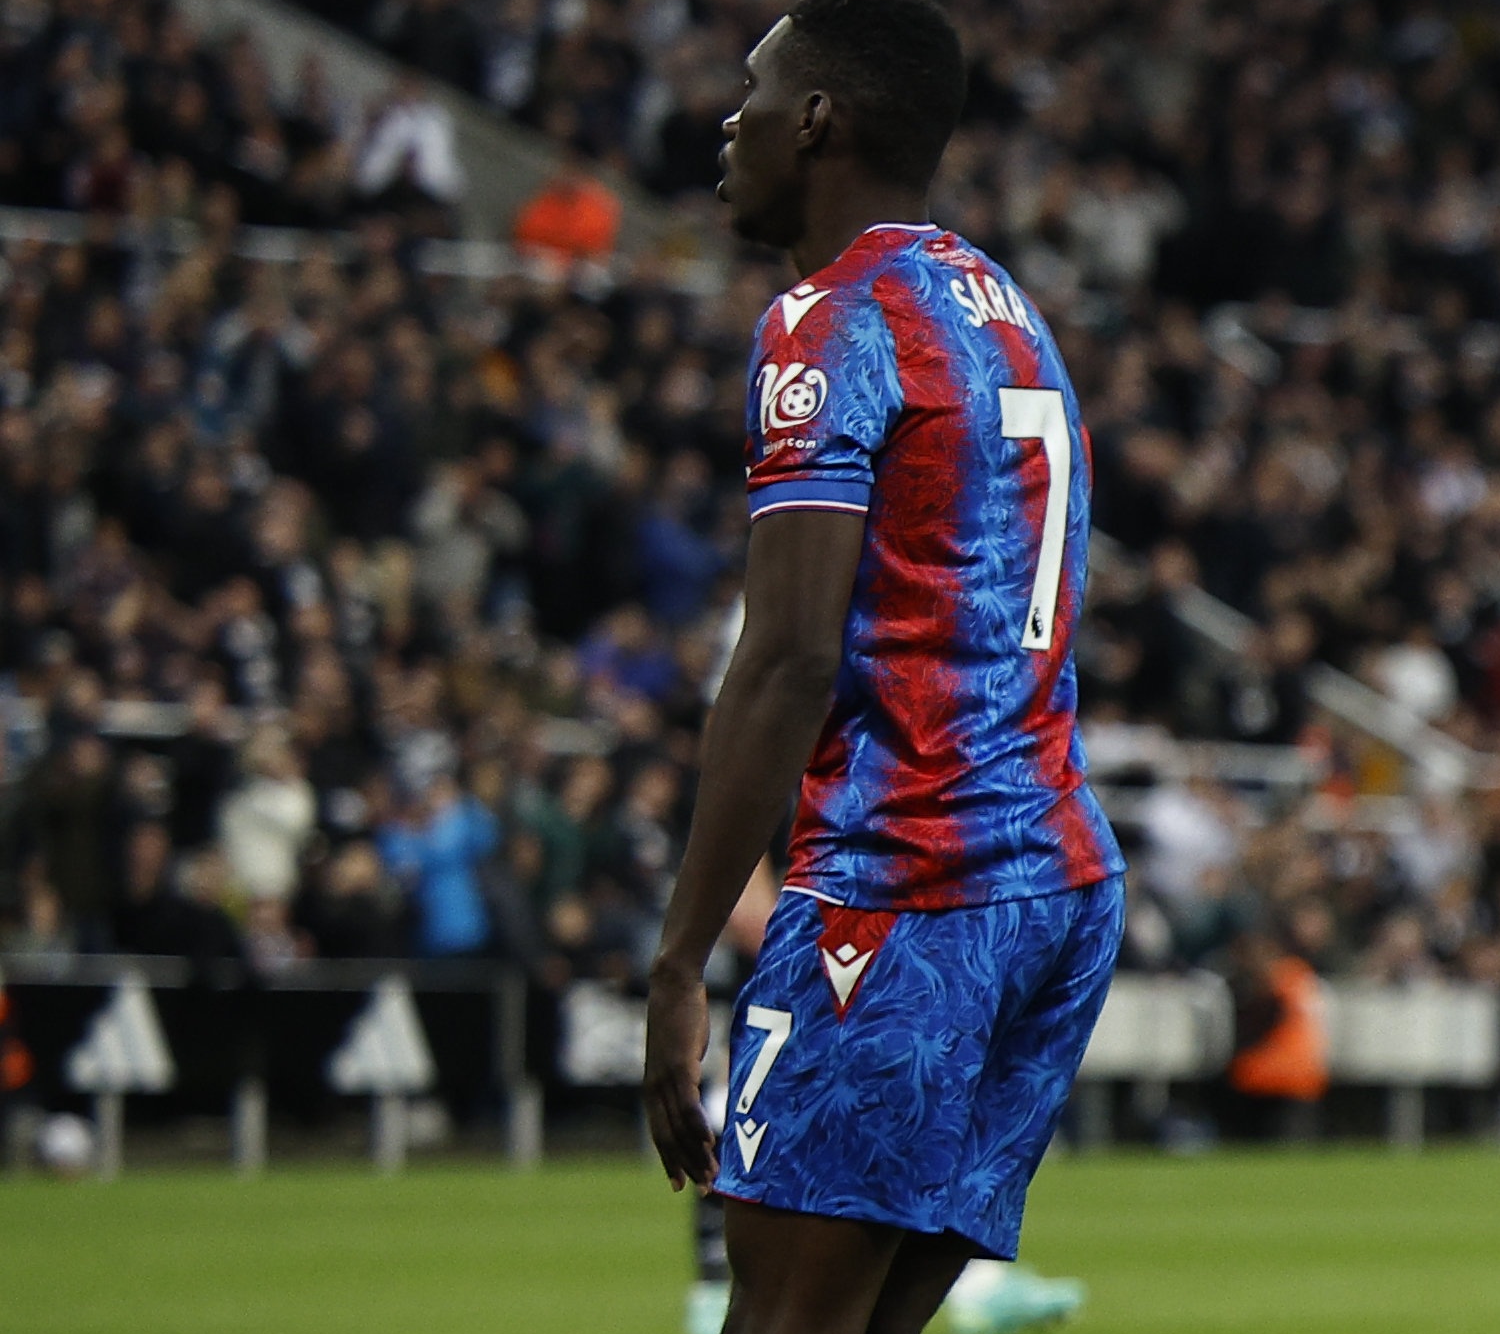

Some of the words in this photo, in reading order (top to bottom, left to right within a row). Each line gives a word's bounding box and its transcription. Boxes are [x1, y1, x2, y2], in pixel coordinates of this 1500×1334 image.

[950, 273, 1038, 336] SARR
[999, 387, 1072, 650] 7
[734, 1005, 793, 1115] 7
